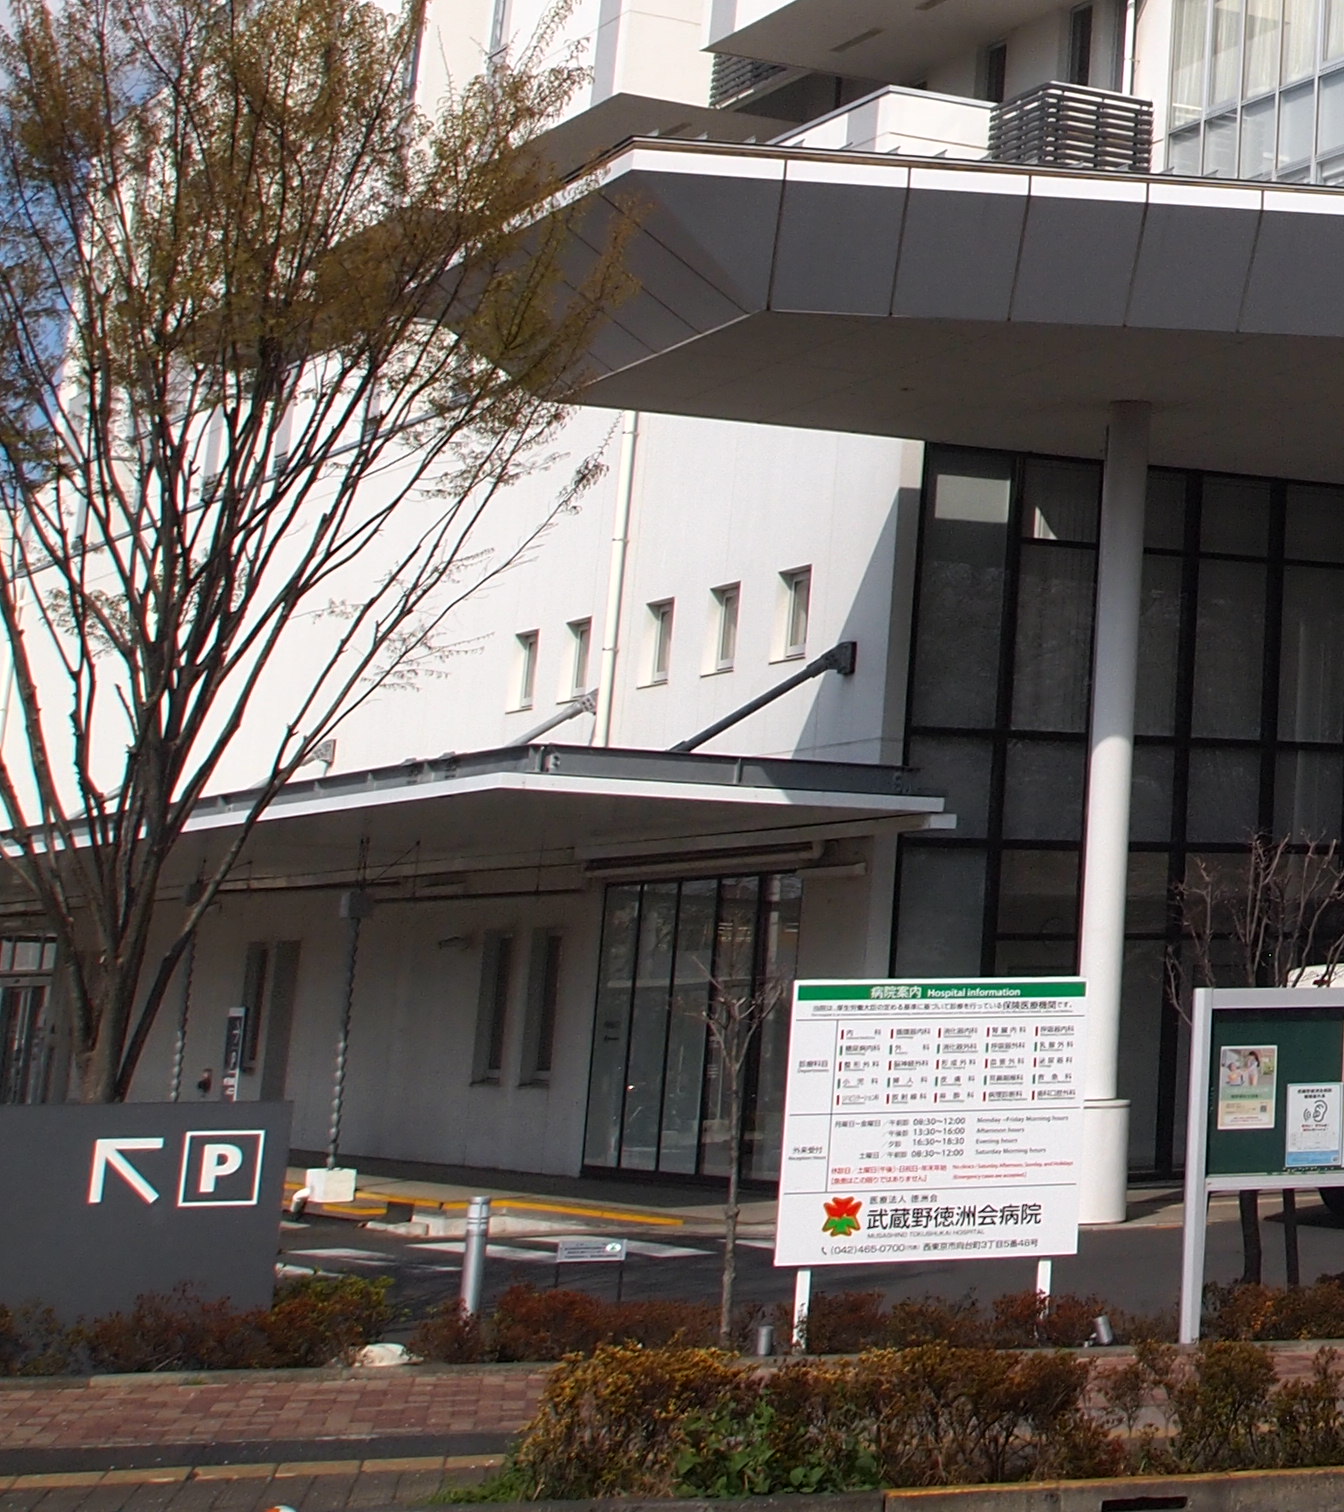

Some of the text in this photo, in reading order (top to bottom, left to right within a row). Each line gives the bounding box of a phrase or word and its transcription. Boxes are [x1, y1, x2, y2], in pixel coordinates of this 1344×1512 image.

[870, 985, 922, 999] 病院案内
[927, 987, 1021, 998] Hospital information
[199, 1143, 243, 1193] P
[869, 1195, 907, 1205] 医療法人
[866, 1202, 1042, 1230] 武蔵野徳洲会病院
